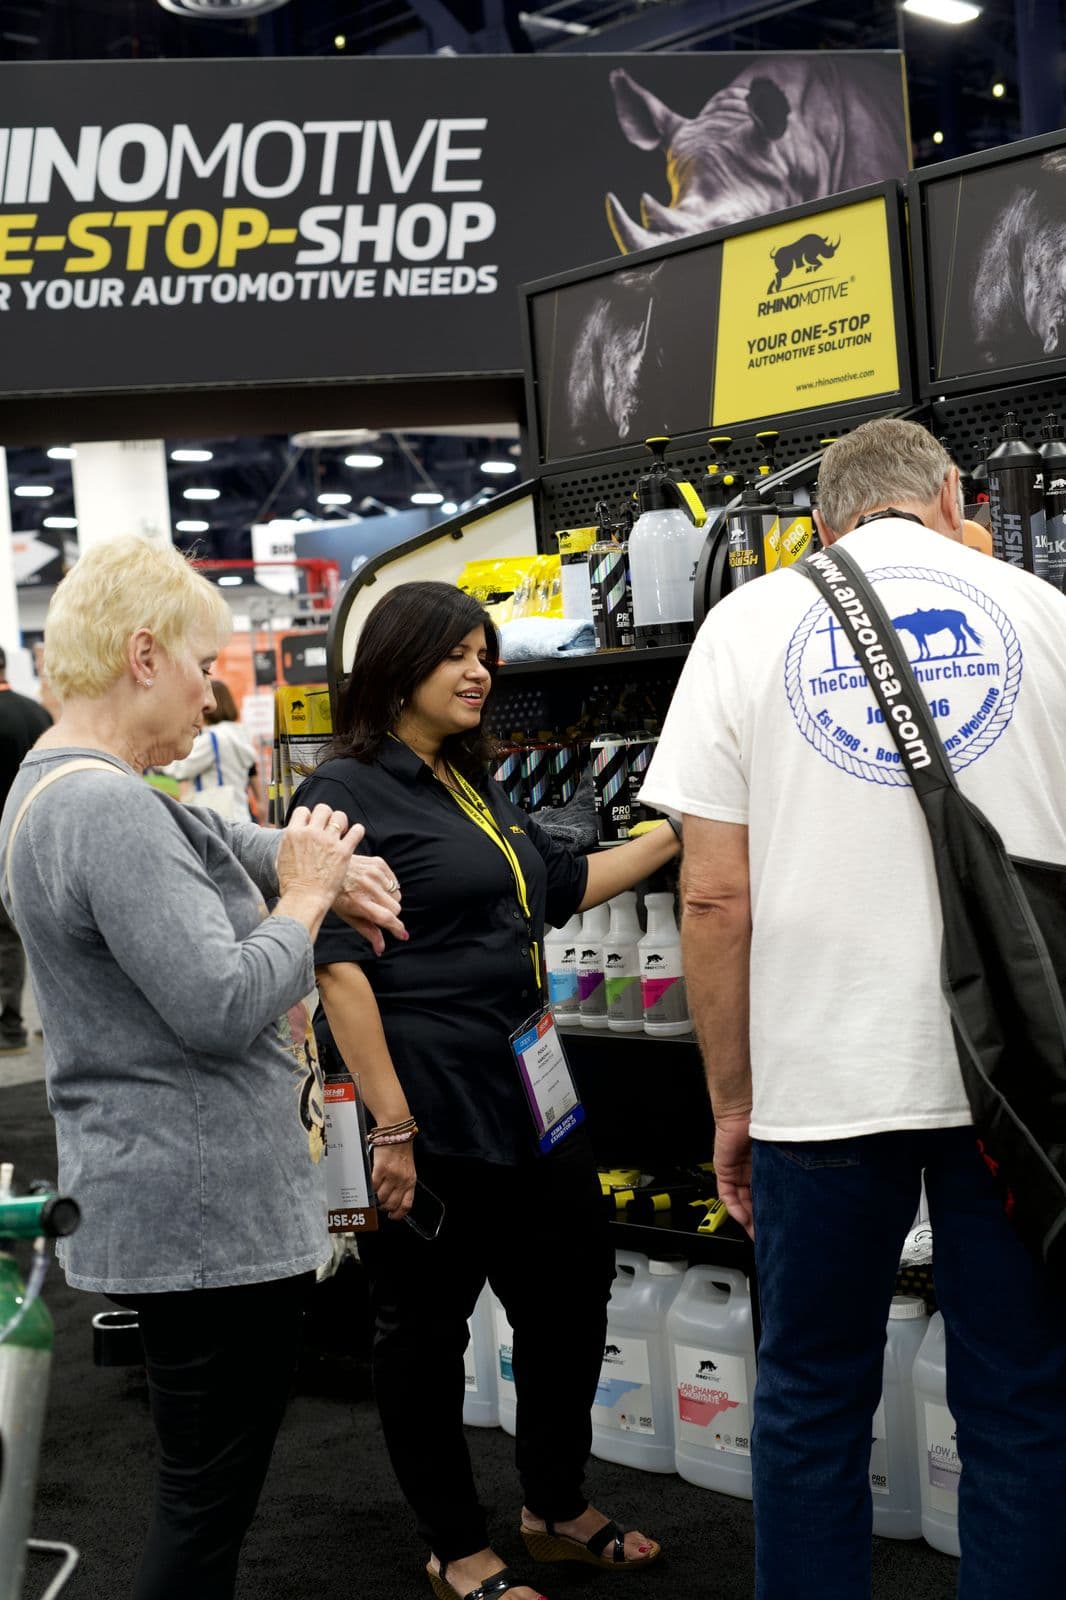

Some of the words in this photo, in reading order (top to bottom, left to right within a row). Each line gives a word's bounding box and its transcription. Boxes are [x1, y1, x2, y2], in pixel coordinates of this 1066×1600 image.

[0, 118, 488, 203] INOMOTIVE
[21, 277, 125, 310] YOUR
[131, 269, 376, 307] AUTOMOTIVE
[383, 264, 499, 297] NEEDS
[757, 281, 849, 318] RHINOMOTIVE
[747, 332, 787, 354] YOUR
[790, 313, 871, 345] ONE-STOP
[747, 344, 816, 370] AUTOMOTIVE
[817, 332, 872, 354] SOLUTION
[795, 368, 875, 392] www.rhinomotive.com
[782, 523, 805, 552] PRO
[790, 531, 810, 557] SERIES
[1003, 513, 1025, 568] NISH
[832, 726, 861, 752] 1998
[958, 687, 1000, 739] Welcome
